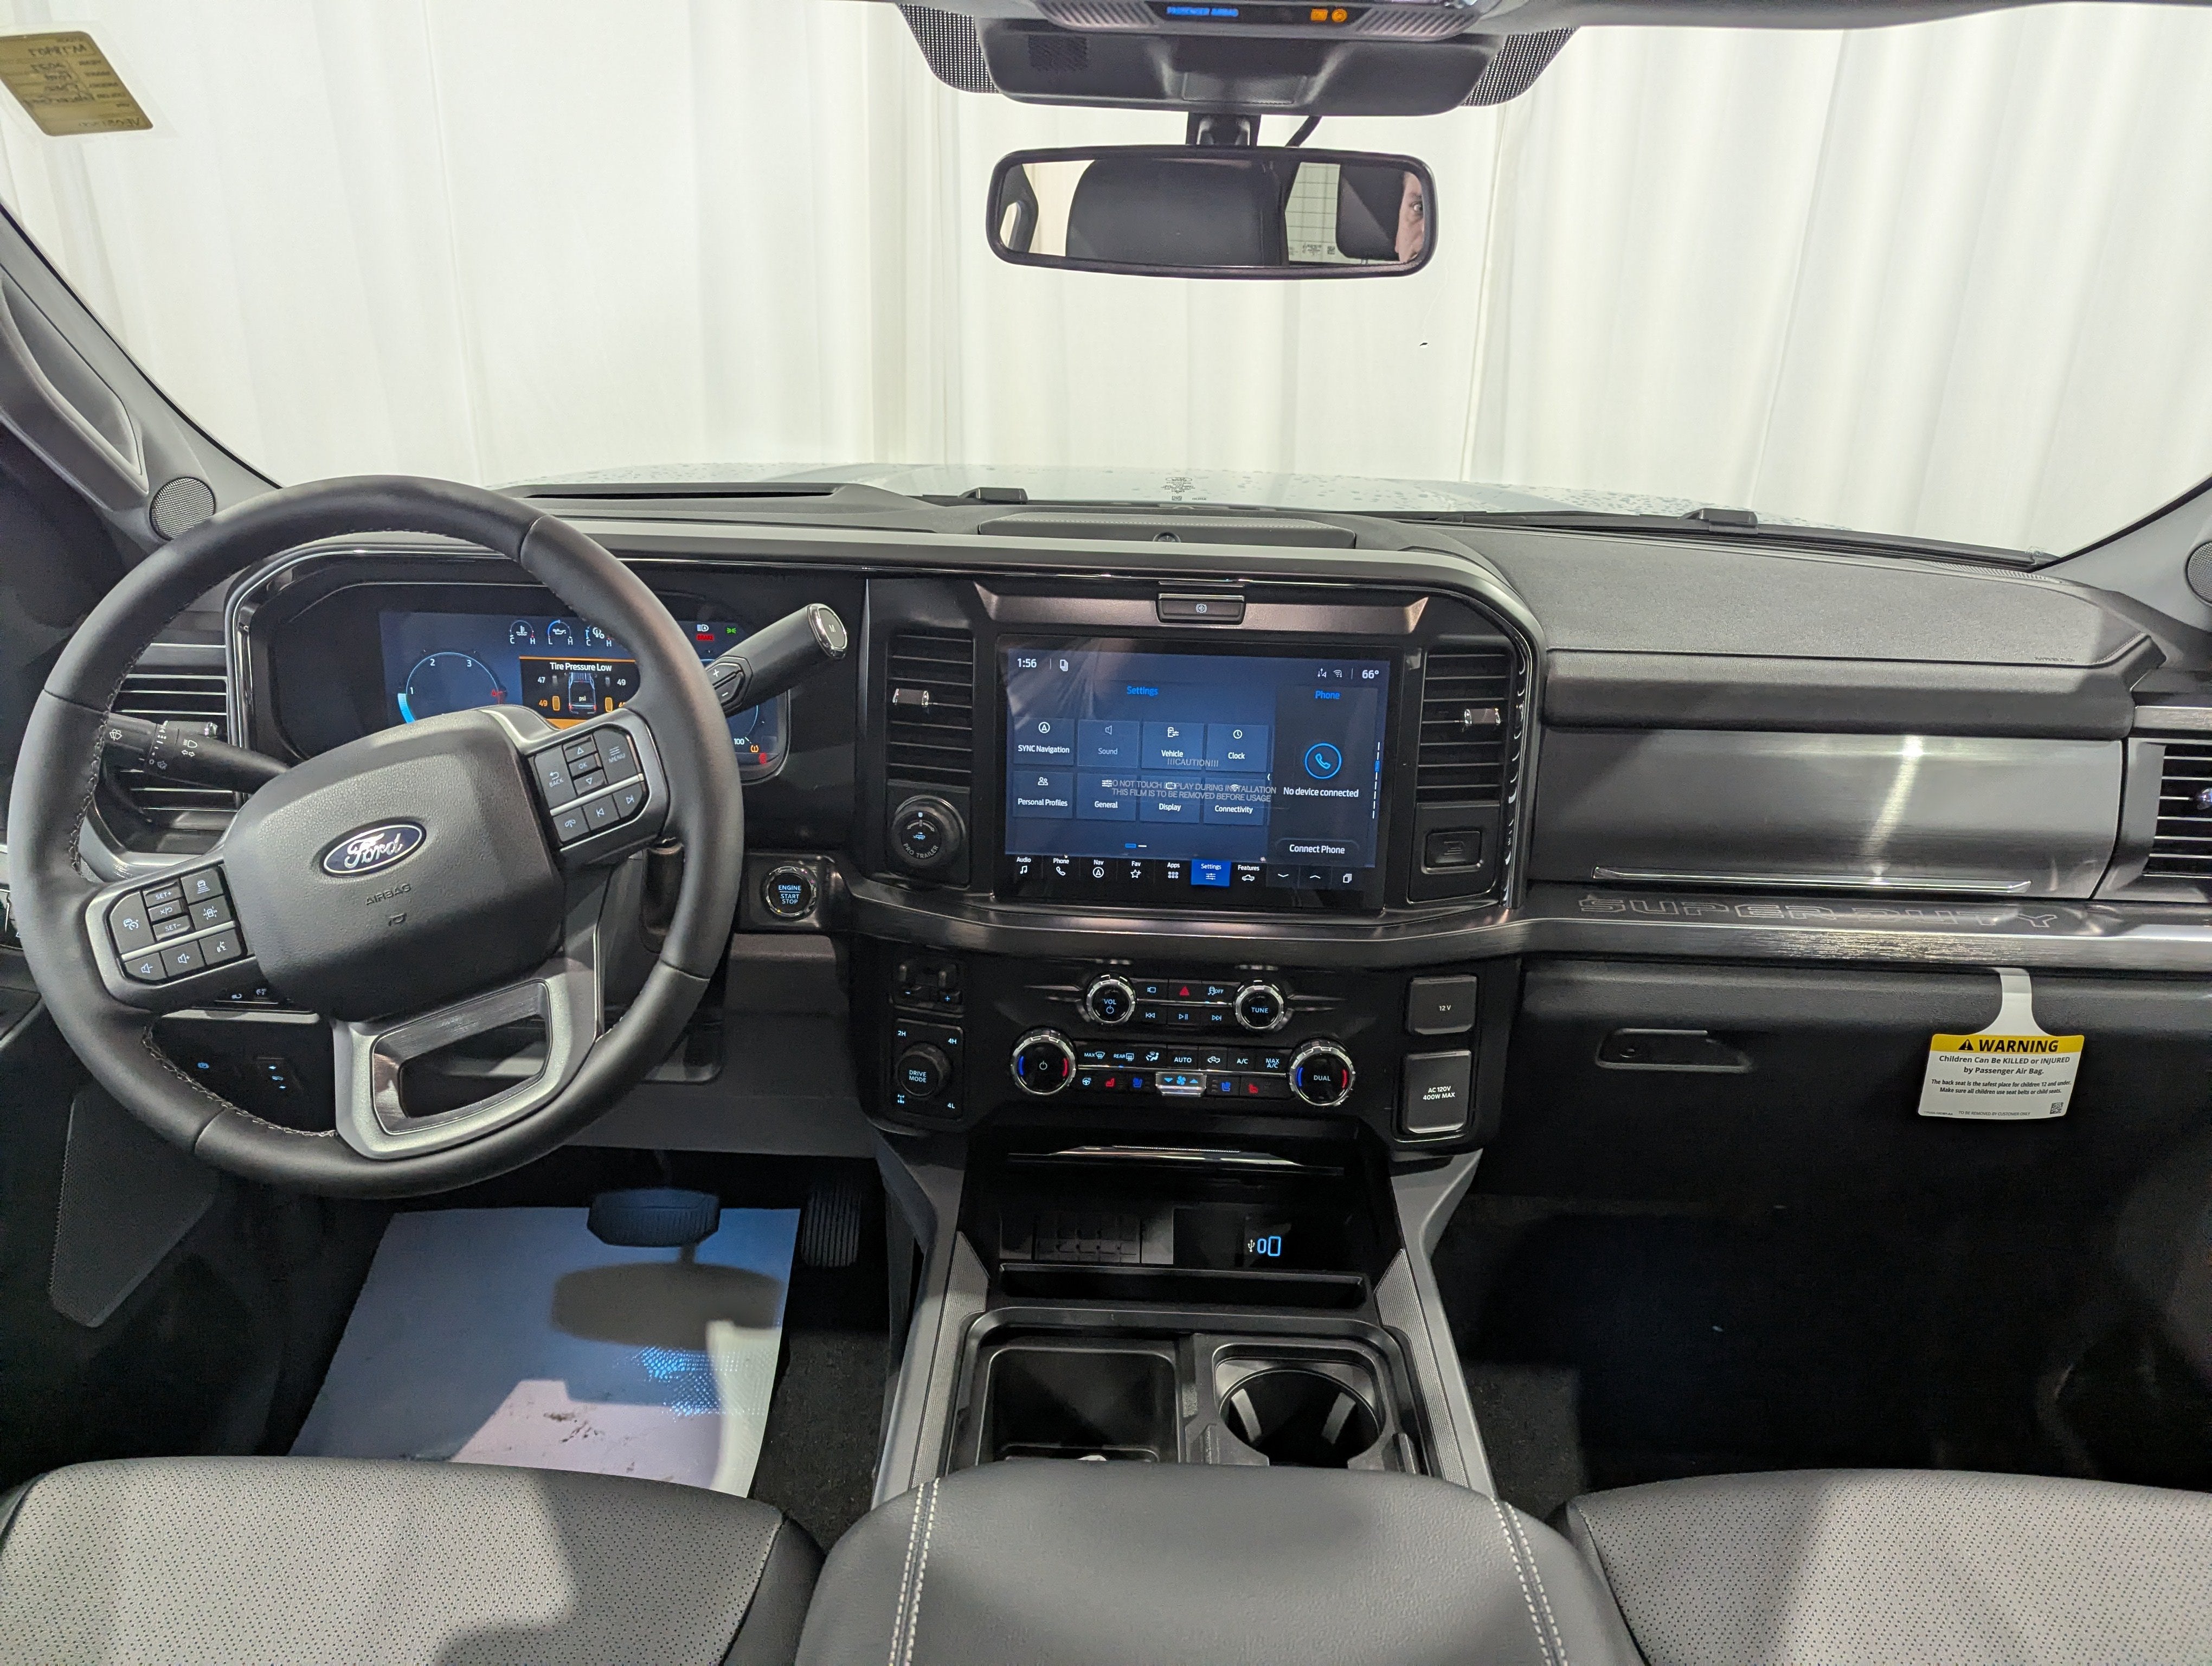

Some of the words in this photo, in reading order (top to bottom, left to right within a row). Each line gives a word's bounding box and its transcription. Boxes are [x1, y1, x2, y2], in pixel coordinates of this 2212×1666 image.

[430, 658, 435, 667] 2
[565, 663, 595, 671] Pressure
[597, 663, 612, 671] Low
[1017, 658, 1037, 668] 1:56
[1362, 670, 1379, 679] 66°
[1127, 685, 1159, 696] Settings
[1315, 690, 1341, 700] Phone
[1018, 745, 1036, 753] SYNC
[1036, 746, 1070, 754] Navigation
[1161, 749, 1184, 758] Vehicle
[609, 753, 625, 763] MENU
[549, 778, 564, 787] BACK
[1195, 783, 1224, 791] DURING
[1225, 784, 1276, 794] INTALLATION
[1283, 787, 1295, 796] No
[1295, 787, 1320, 797] device
[1320, 789, 1359, 798] connected
[1112, 788, 1128, 796] THIS
[1179, 791, 1215, 799] REMOVED
[1216, 792, 1245, 801] BEFORE
[1246, 794, 1271, 802] USAGE
[1018, 798, 1044, 806] Personal
[1045, 799, 1068, 807] Profiles
[1095, 800, 1118, 809] General
[1159, 803, 1181, 812] Display
[1214, 805, 1253, 814] Connectivity
[344, 832, 403, 868] Ford
[903, 843, 914, 855] PRO
[916, 845, 938, 858] TRAILER
[1289, 844, 1320, 853] Connect
[1321, 845, 1345, 854] Phone
[365, 883, 411, 906] AIRBAG
[1578, 899, 1836, 920] SUPER
[1851, 907, 2057, 928] DUTY
[1979, 1039, 2059, 1053] WARNING
[2040, 1057, 2070, 1065] INJURED
[909, 1069, 927, 1078] DRIVE
[1975, 1067, 2015, 1075] Passenger
